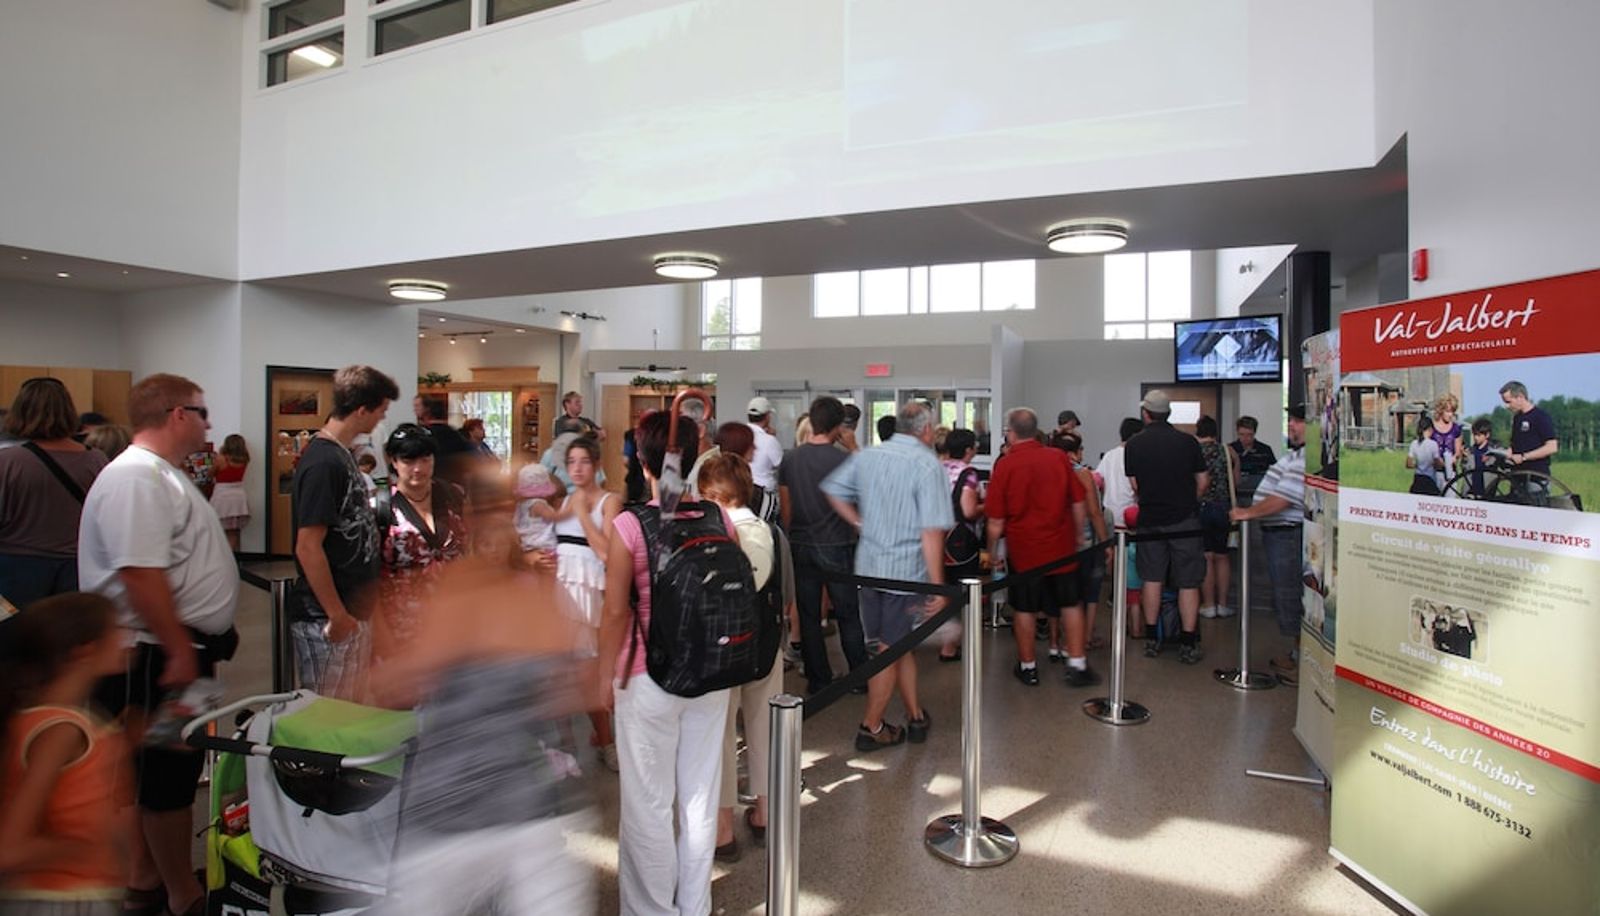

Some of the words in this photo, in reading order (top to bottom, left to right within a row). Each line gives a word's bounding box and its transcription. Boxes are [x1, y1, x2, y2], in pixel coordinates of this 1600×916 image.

[1374, 293, 1541, 344] Val-Jalbert
[1390, 346, 1438, 357] AUTHENTIQUE
[1440, 344, 1450, 352] ET
[1451, 337, 1518, 351] SPECTACULAIRE
[1349, 506, 1385, 519] PRENEZ
[1386, 511, 1410, 522] PART
[1420, 515, 1435, 526] UN
[1435, 518, 1483, 533] VOYAGE
[1485, 525, 1518, 538] DANS
[1521, 529, 1539, 541] LE
[1540, 532, 1592, 548] TEMPS
[1417, 501, 1489, 518] NOUVEAUTÉS
[1371, 532, 1413, 549] Circuit
[1415, 539, 1430, 552] de
[1433, 542, 1472, 560] visite
[1400, 642, 1438, 665] Studio
[1440, 657, 1458, 671] de
[1461, 663, 1503, 688] photo
[1370, 706, 1418, 743] Entrez
[1421, 726, 1458, 761] dans
[1408, 695, 1421, 706] DE
[1420, 700, 1472, 727] COMPAGNIE
[1473, 721, 1491, 735] DES
[1536, 746, 1551, 760] 20
[1370, 750, 1453, 798] www.valjalbert.com
[1456, 792, 1463, 803] 1
[1464, 796, 1482, 813] 888
[1483, 806, 1533, 840] 675-3132
